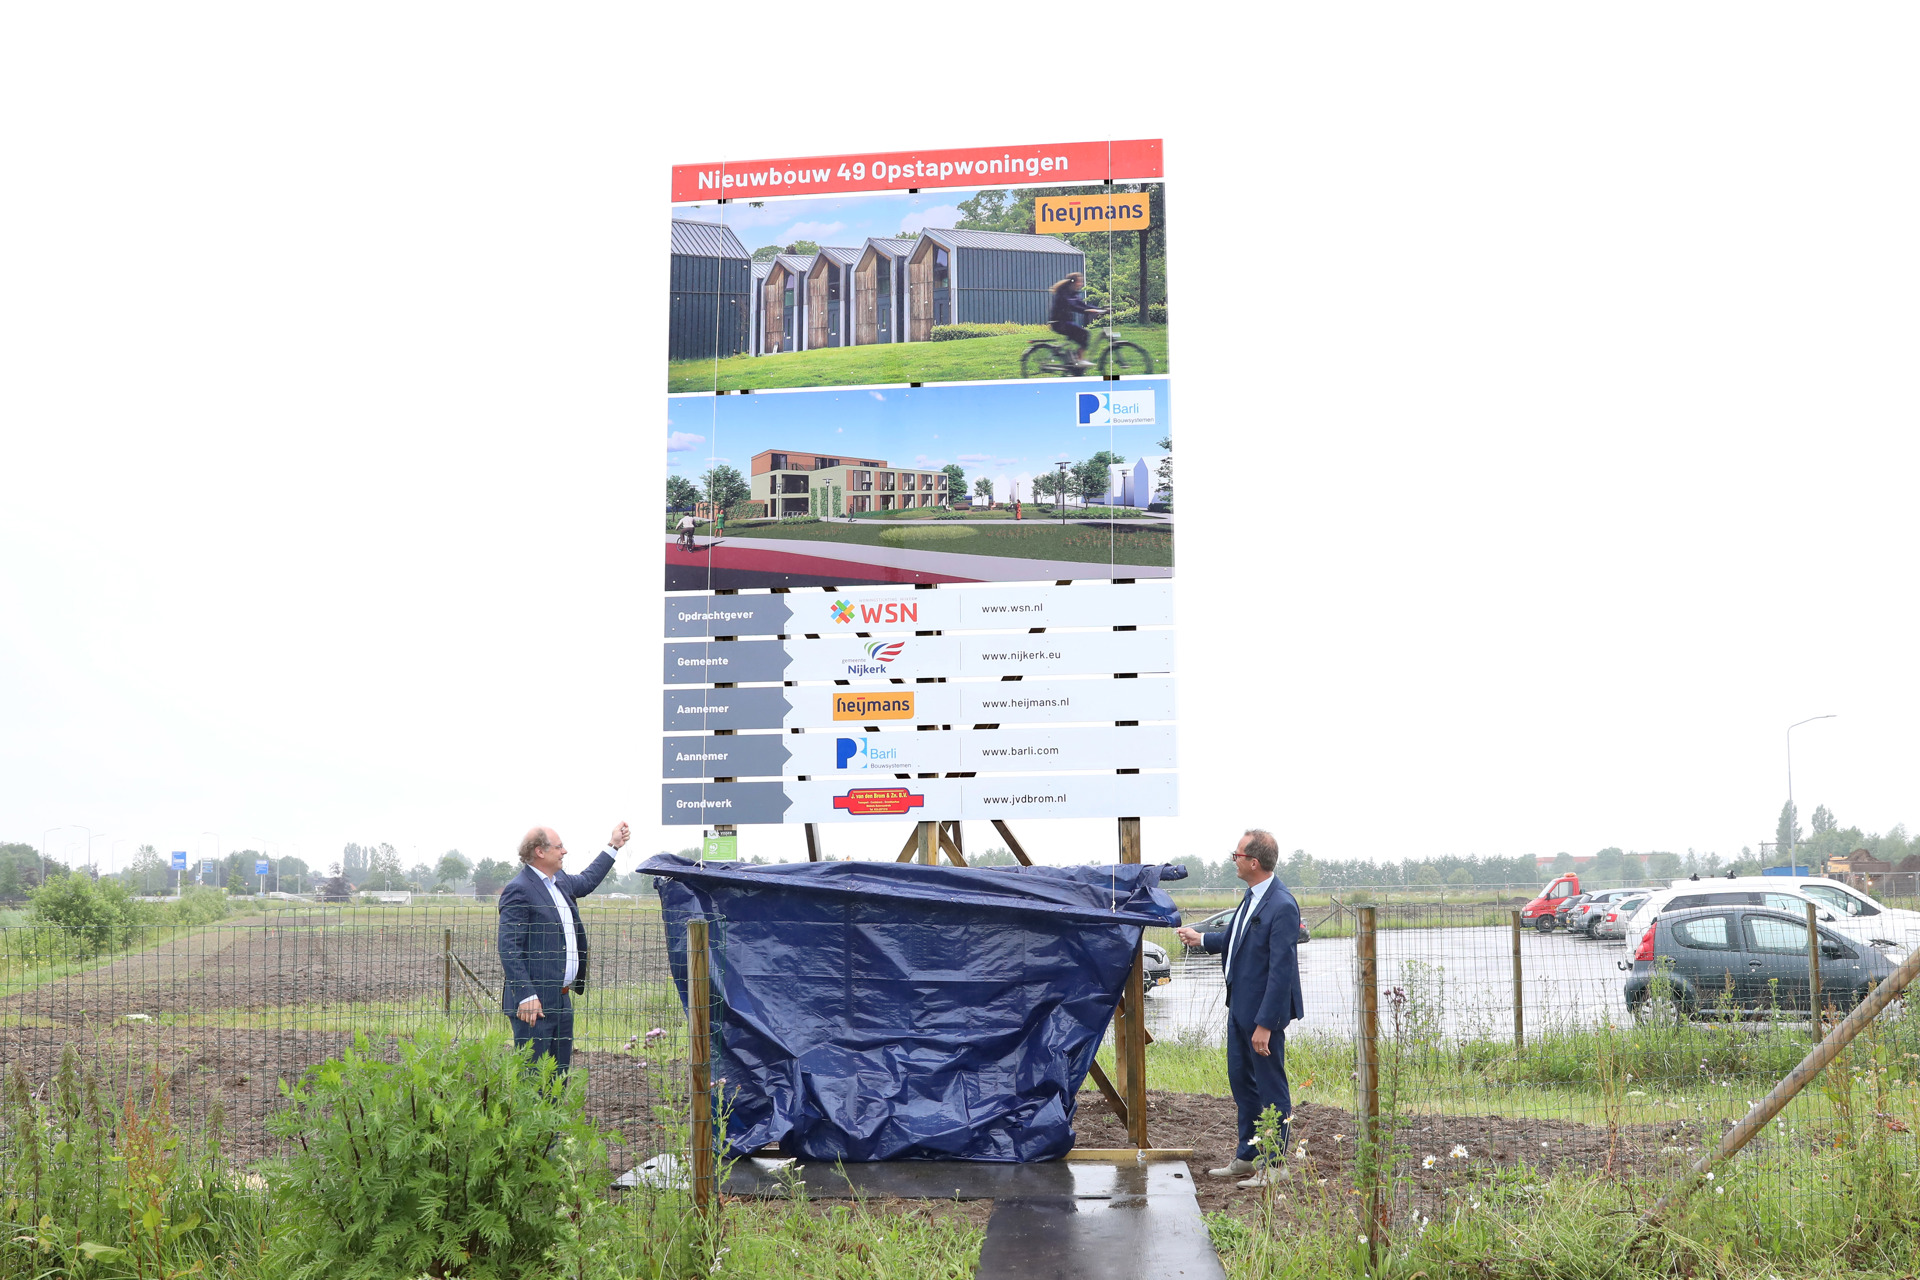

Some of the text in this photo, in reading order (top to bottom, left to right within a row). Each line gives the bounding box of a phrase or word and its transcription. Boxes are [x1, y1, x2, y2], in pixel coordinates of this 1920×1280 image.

[698, 154, 1069, 189] Nieuwbouw 49 Opstapwoningen
[1112, 403, 1139, 414] Barli
[860, 602, 918, 624] WSN
[982, 603, 1043, 613] www.wsn.nl
[678, 610, 754, 621] Opdrachtgever
[677, 656, 729, 667] Gemeente
[982, 651, 1061, 662] www.nijkerk.eu
[848, 664, 887, 677] Nijkerk
[676, 704, 729, 714] Aannemer
[982, 698, 1070, 709] www.heijmans.nl
[676, 751, 728, 761] Aannemer
[870, 748, 897, 759] Barli
[982, 746, 1059, 756] www.barli.com
[676, 799, 732, 809] Grondwerk
[983, 794, 1067, 805] www.jvdbrom.nl
